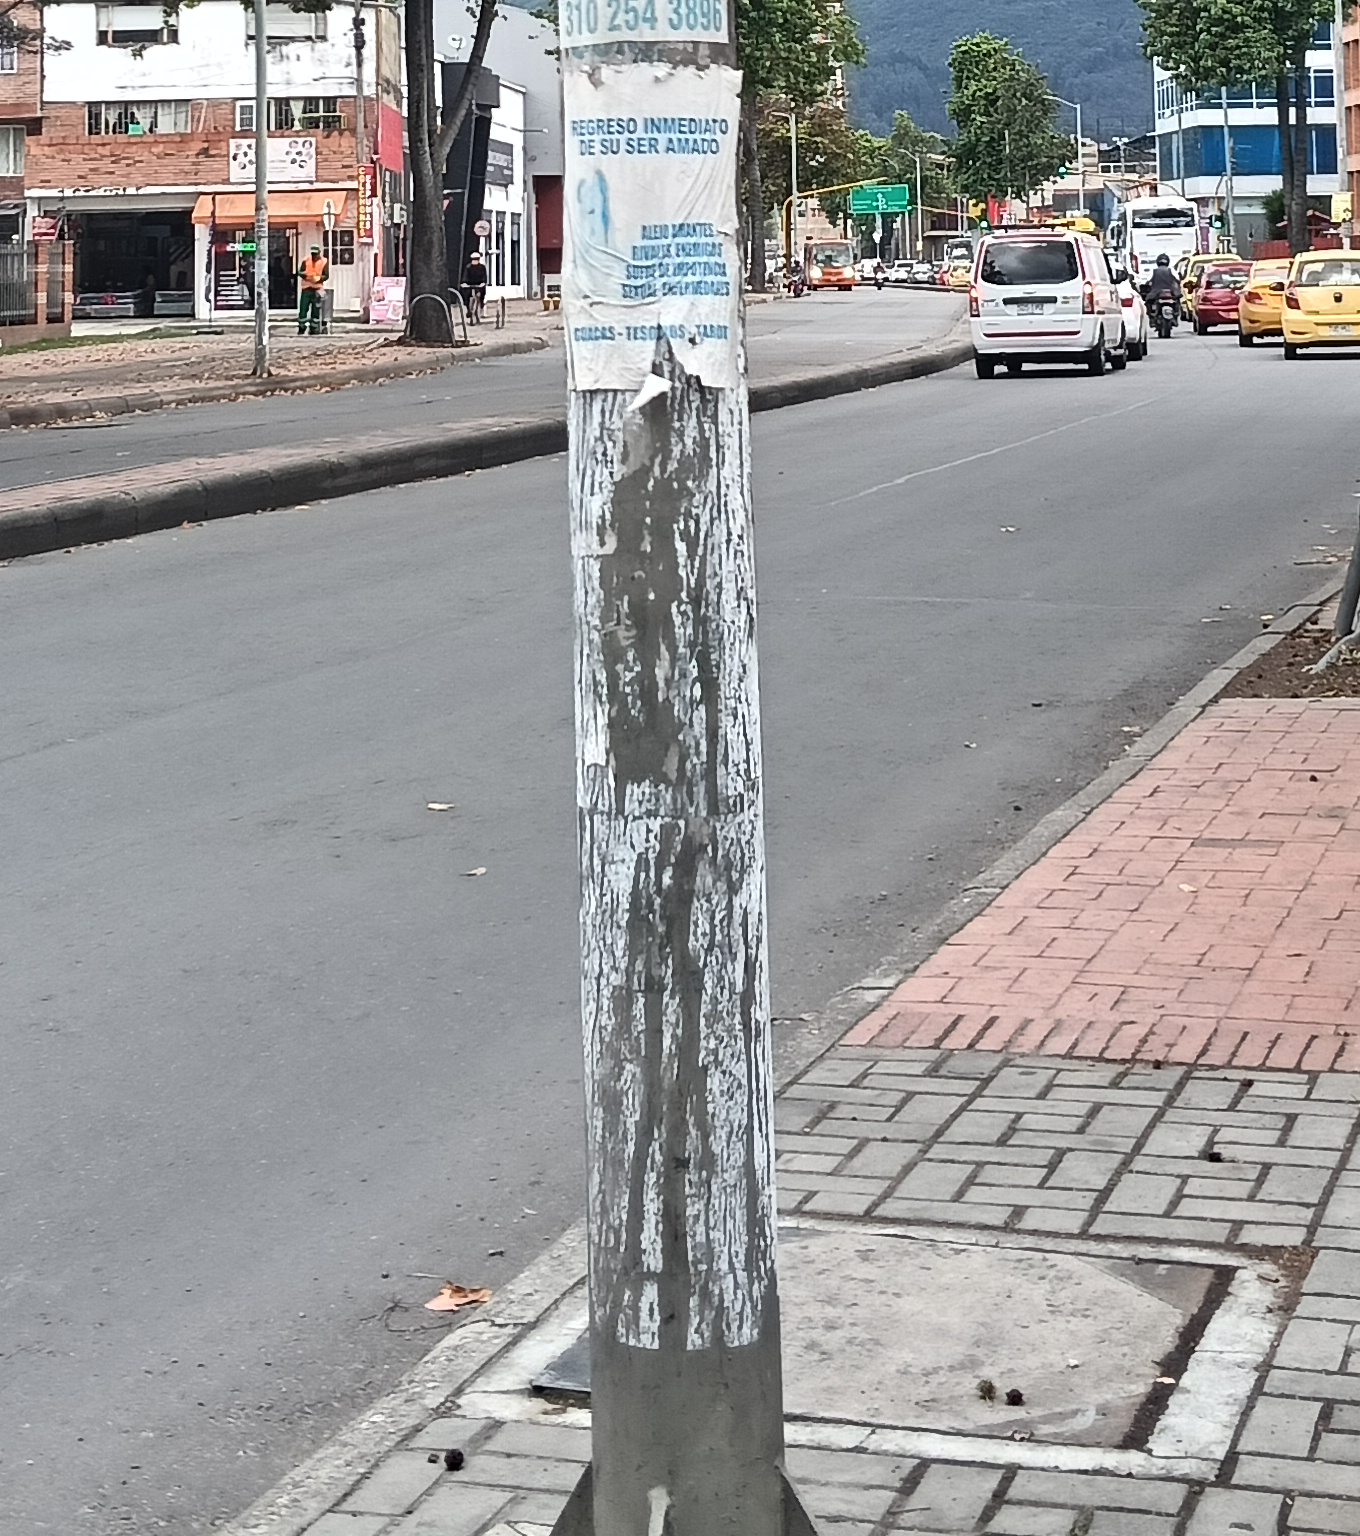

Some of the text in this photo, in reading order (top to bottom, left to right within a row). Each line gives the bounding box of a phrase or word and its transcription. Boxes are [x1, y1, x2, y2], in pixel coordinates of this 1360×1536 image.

[572, 116, 729, 137] REGRESO INMEDIATO
[580, 137, 720, 156] DE SU SER AMADO
